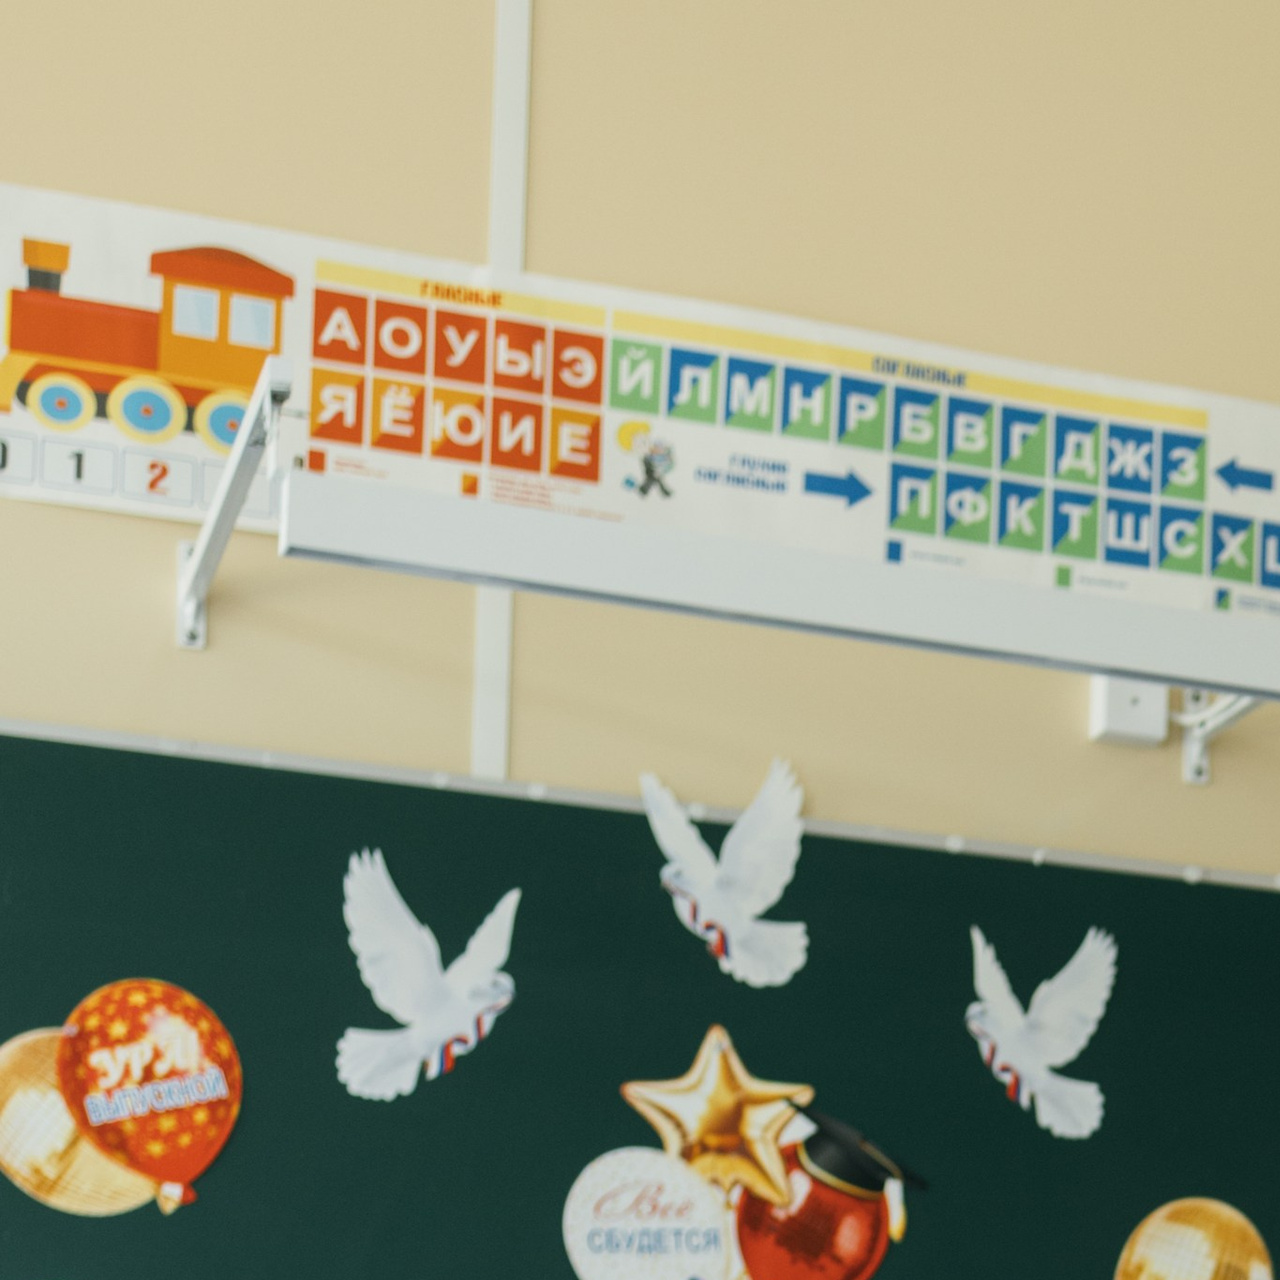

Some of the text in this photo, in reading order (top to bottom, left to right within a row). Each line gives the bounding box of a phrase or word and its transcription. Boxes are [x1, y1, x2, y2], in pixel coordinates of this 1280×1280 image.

[319, 306, 597, 387] А О У Ы Э
[319, 384, 593, 466] Я Ё Ю И Е
[617, 344, 1200, 486] Й Л М Н Р Б В Г Д Ж З
[69, 451, 170, 496] 1 2
[898, 476, 932, 519] П
[946, 484, 991, 526] Ф
[1006, 492, 1037, 536] К
[1058, 500, 1093, 542] Т
[1106, 513, 1152, 552] Ш
[1163, 519, 1198, 558] С
[1216, 526, 1250, 569] Х
[84, 1065, 230, 1126] ВЫПУСКНОЙ
[586, 1226, 721, 1256] СБУДЕТСЯ
